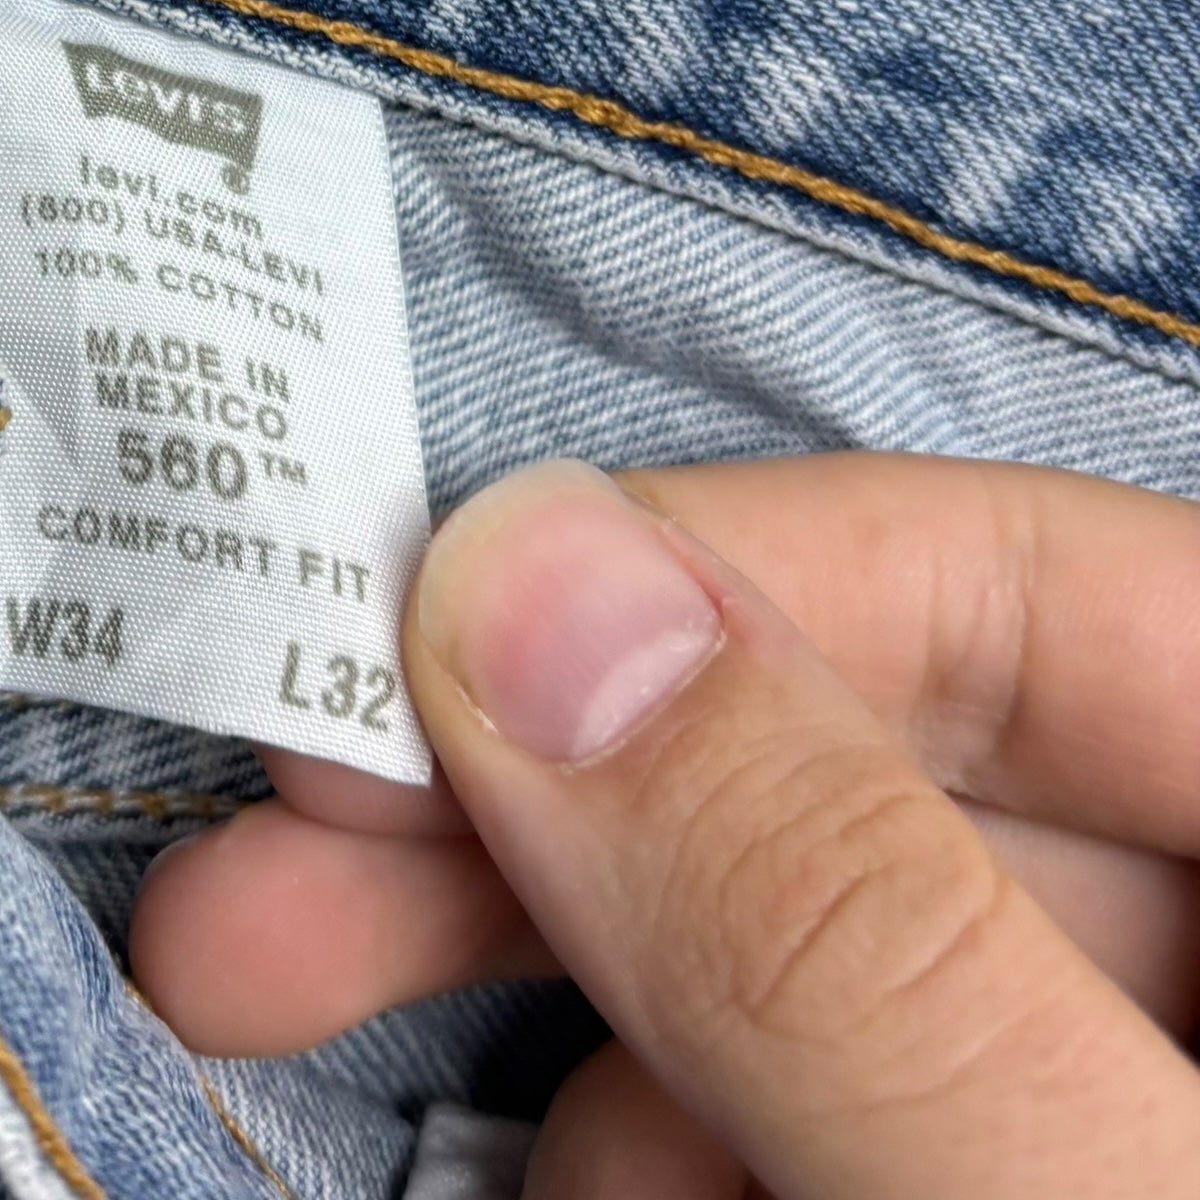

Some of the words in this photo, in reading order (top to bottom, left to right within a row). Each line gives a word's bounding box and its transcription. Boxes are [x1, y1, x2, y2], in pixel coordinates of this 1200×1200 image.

[80, 155, 264, 238] levi.com
[35, 246, 139, 286] 100%
[156, 262, 324, 344] COTTON
[85, 326, 224, 384] MADE
[246, 356, 290, 402] IN
[94, 370, 288, 441] MEXICO
[36, 504, 278, 578] COMFORT
[298, 547, 371, 603] FIT
[6, 594, 125, 669] W34
[278, 642, 397, 734] L32
